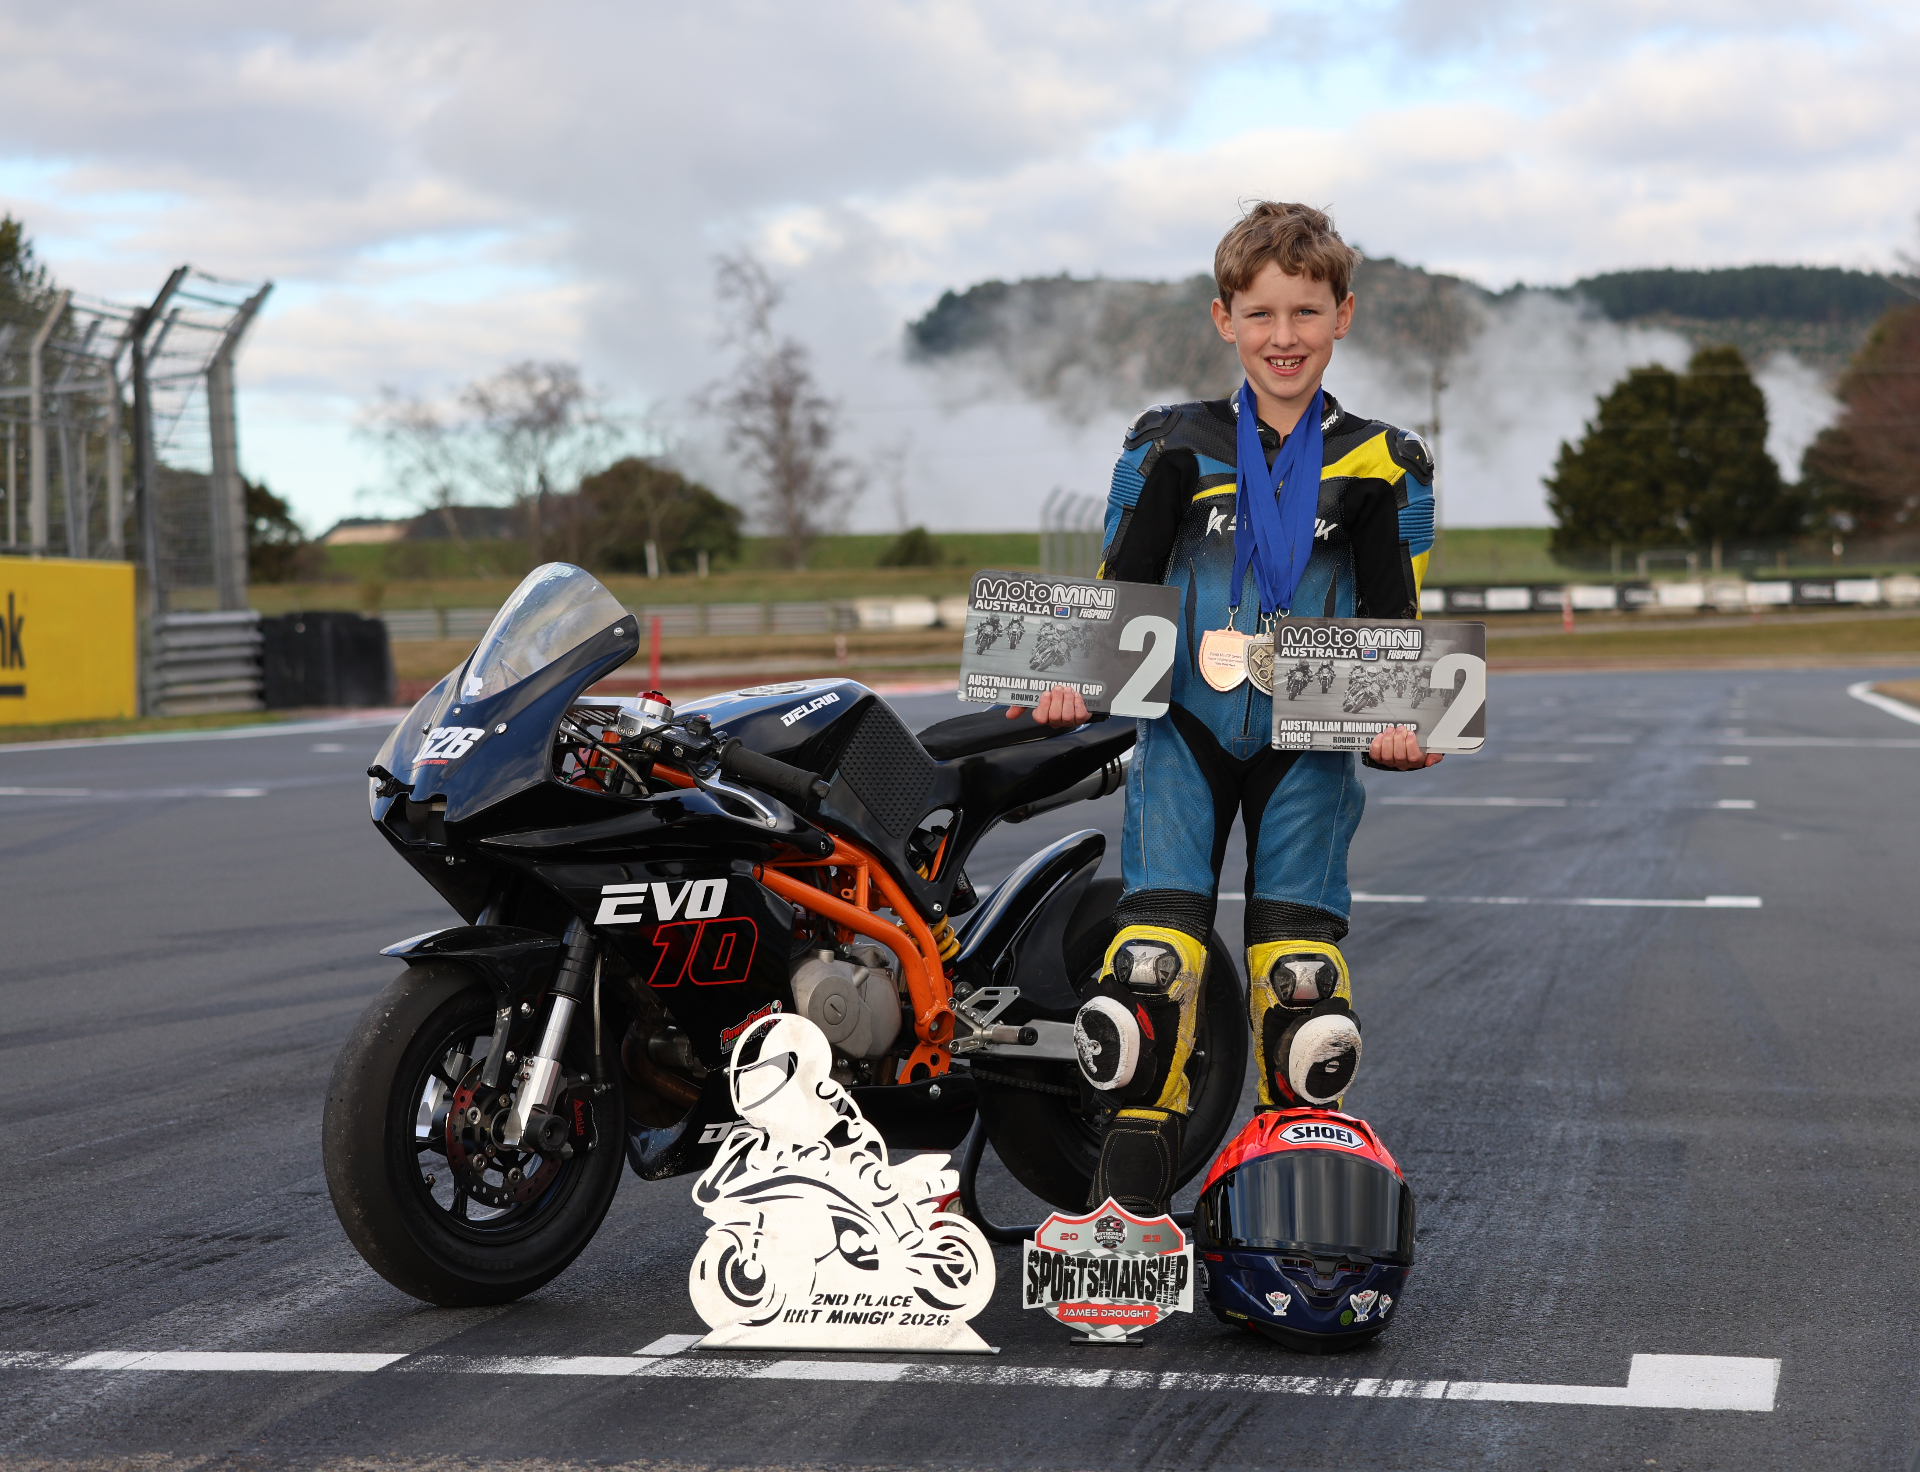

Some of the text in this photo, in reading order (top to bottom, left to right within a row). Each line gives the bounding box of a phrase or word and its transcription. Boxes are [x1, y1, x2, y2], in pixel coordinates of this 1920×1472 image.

[1321, 410, 1339, 432] ARK
[975, 600, 1051, 615] AUSTRALIA
[1281, 647, 1358, 659] AUSTRALIA
[1110, 615, 1178, 719] 2
[967, 674, 1028, 690] AUSTRALIAN
[1082, 684, 1103, 696] CUP
[967, 686, 998, 699] 110CC
[1010, 692, 1034, 702] ROUND
[1034, 694, 1040, 703] 2
[1427, 653, 1486, 749] 2
[780, 692, 840, 727] DELIRIO
[1280, 720, 1341, 732] AUSTRALIAN
[1280, 732, 1311, 743] 110CC
[1332, 736, 1356, 744] ROUND
[594, 878, 728, 925] EVO
[647, 916, 759, 987] 10
[1292, 1126, 1353, 1144] SHOEI
[1060, 1232, 1161, 1243] 20 23
[1026, 1249, 1189, 1306] SPORTSMANSHIP
[811, 1293, 914, 1307] 2ND PLACE
[826, 1310, 895, 1325] MINIGP
[898, 1312, 951, 1327] 2026
[1062, 1308, 1151, 1318] JAMES DROUGHT
